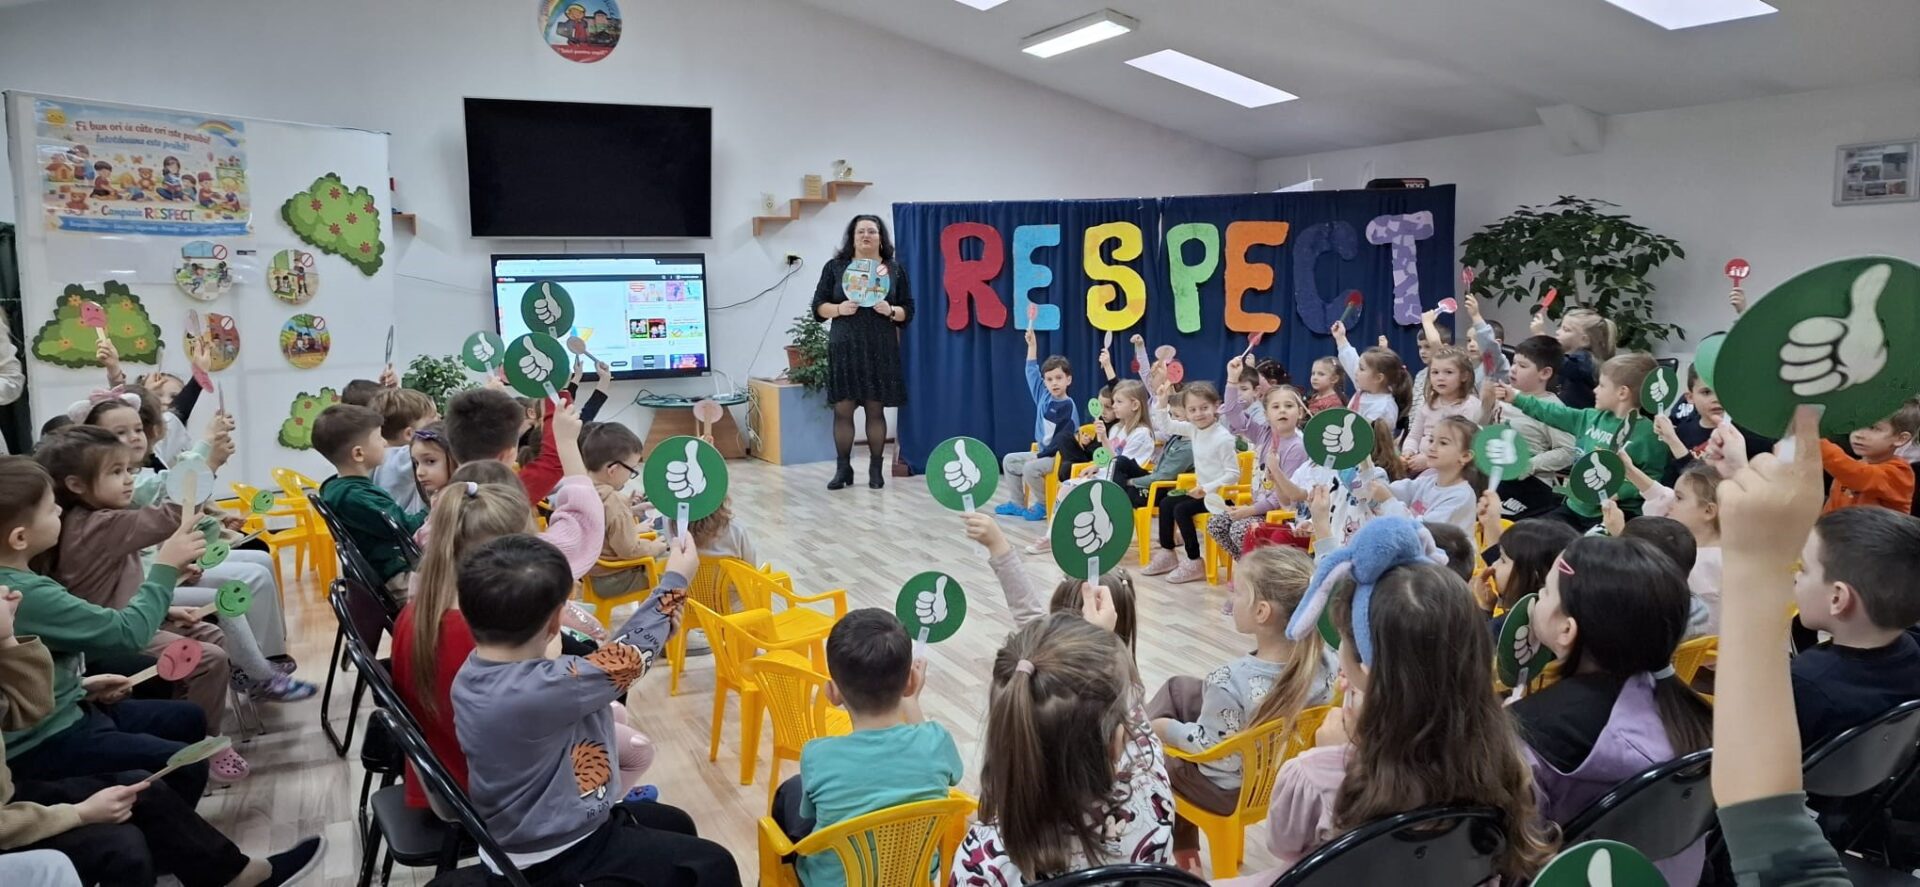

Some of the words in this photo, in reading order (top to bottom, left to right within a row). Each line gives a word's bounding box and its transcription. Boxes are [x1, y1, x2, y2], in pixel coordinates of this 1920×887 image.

[89, 121, 108, 131] bun
[109, 121, 123, 131] ori
[154, 126, 167, 135] ori
[144, 207, 194, 221] RESPECT
[940, 210, 1435, 335] RESPECT
